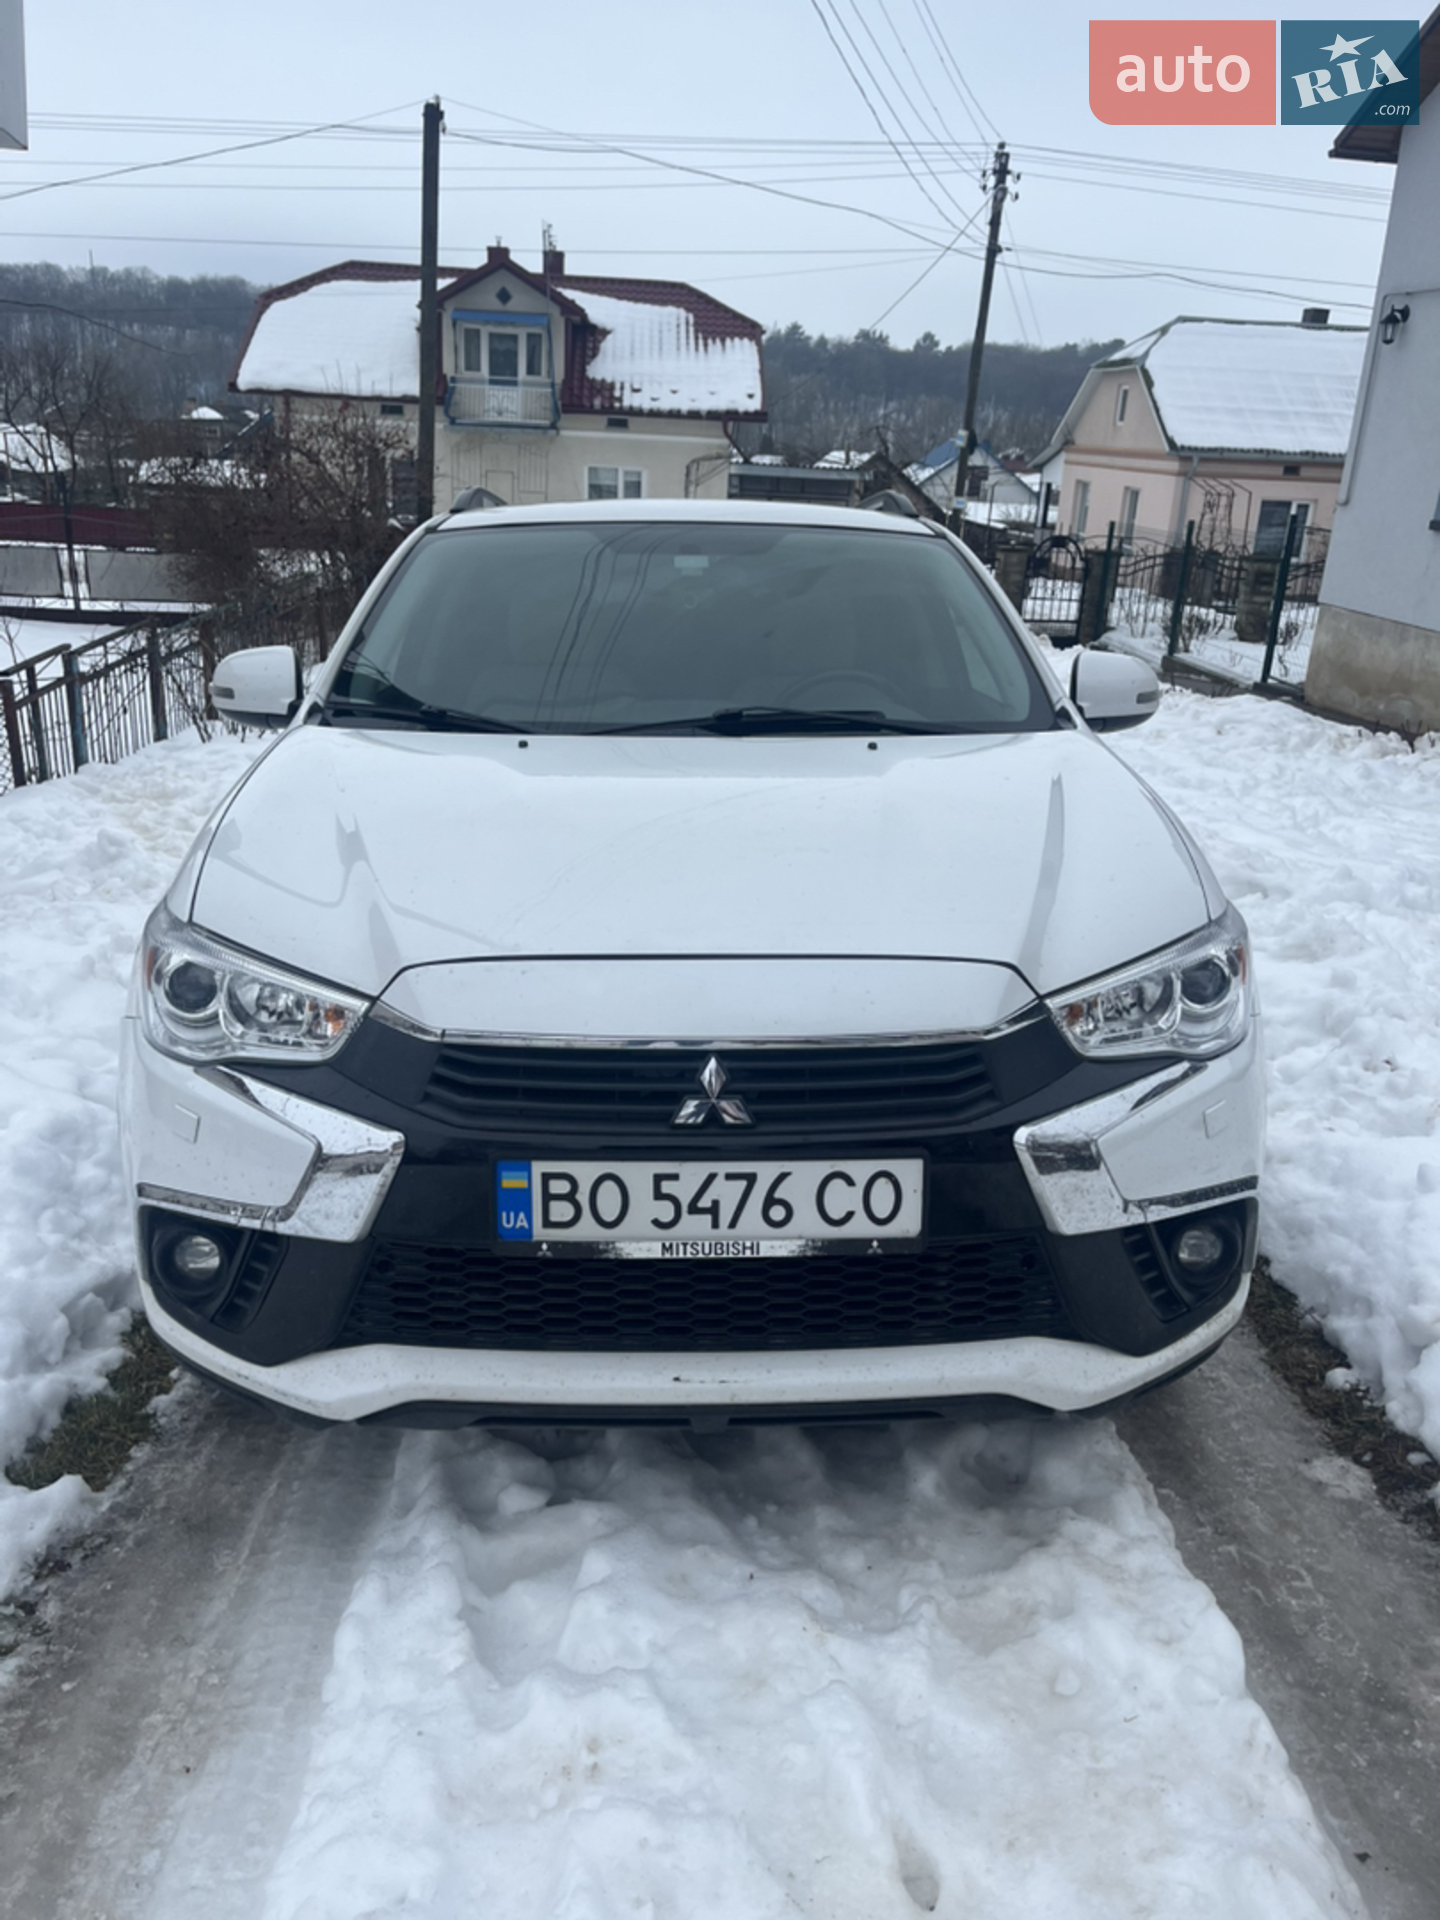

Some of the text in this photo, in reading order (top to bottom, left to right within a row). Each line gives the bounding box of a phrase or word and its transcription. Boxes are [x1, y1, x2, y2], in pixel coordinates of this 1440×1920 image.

[540, 1169, 903, 1230] BO 5476 CO
[501, 1211, 529, 1229] UA
[660, 1240, 760, 1257] MITSUBISHI
